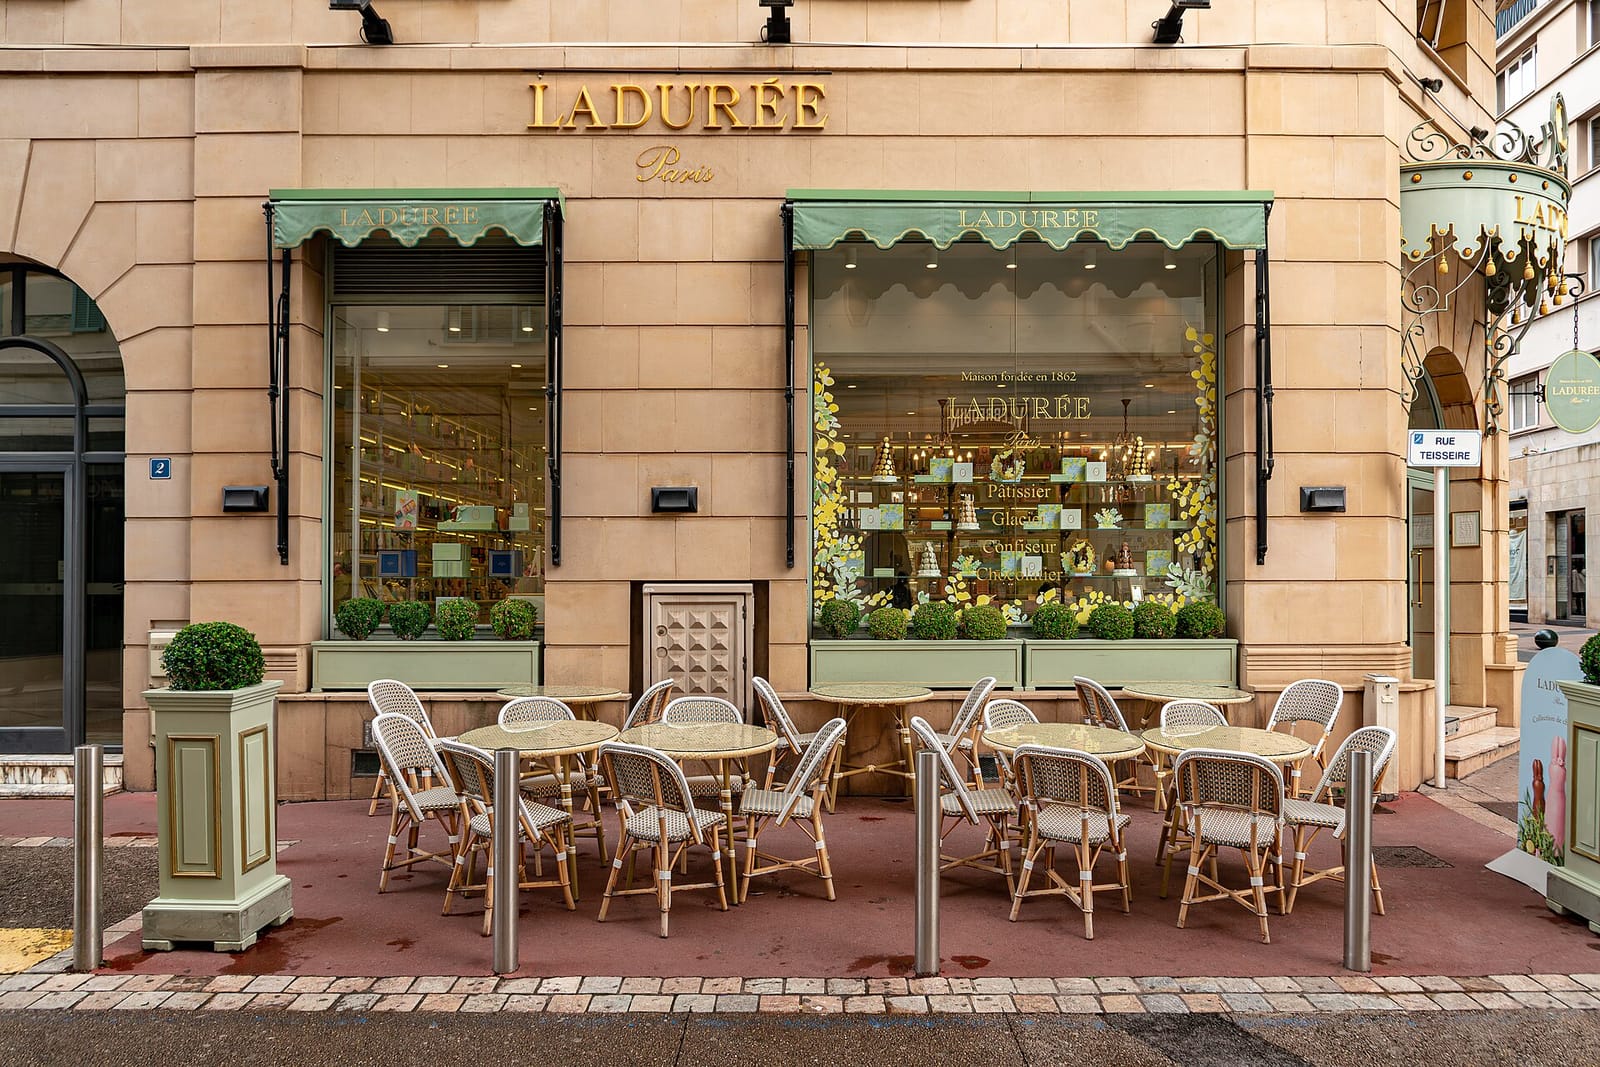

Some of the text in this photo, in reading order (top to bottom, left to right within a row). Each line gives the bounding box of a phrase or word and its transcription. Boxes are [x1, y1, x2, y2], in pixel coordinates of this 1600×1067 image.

[527, 77, 829, 131] LADURÉE
[635, 145, 713, 183] Paris
[957, 208, 1100, 228] LADURÉE
[961, 370, 1077, 382] Maison fondée en 1862
[947, 394, 1092, 420] LADURÉE
[1004, 430, 1041, 448] Paris
[1435, 436, 1456, 446] RUE
[1420, 451, 1471, 460] TEISSEIRE
[155, 462, 164, 474] 2
[988, 484, 1051, 498] Pâtissier
[982, 539, 1057, 554] Confiseur
[976, 566, 1064, 581] Chocolatier
